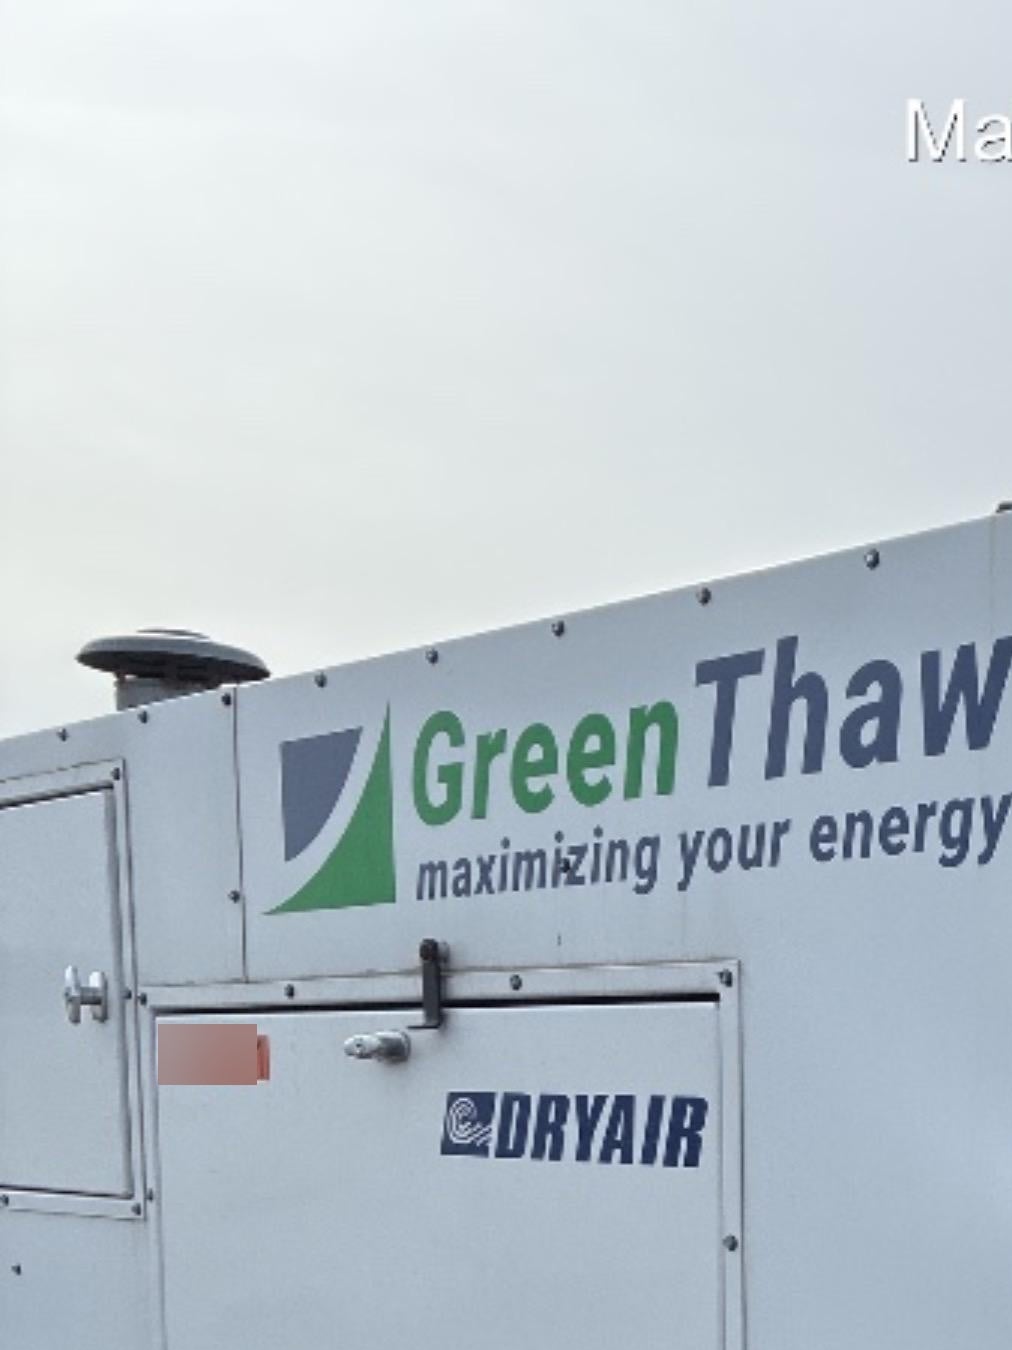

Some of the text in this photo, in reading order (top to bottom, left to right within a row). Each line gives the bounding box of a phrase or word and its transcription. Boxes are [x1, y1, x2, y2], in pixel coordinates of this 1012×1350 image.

[415, 826, 660, 901] maximizing
[677, 817, 792, 891] your
[494, 1091, 709, 1168] DRYAIR
